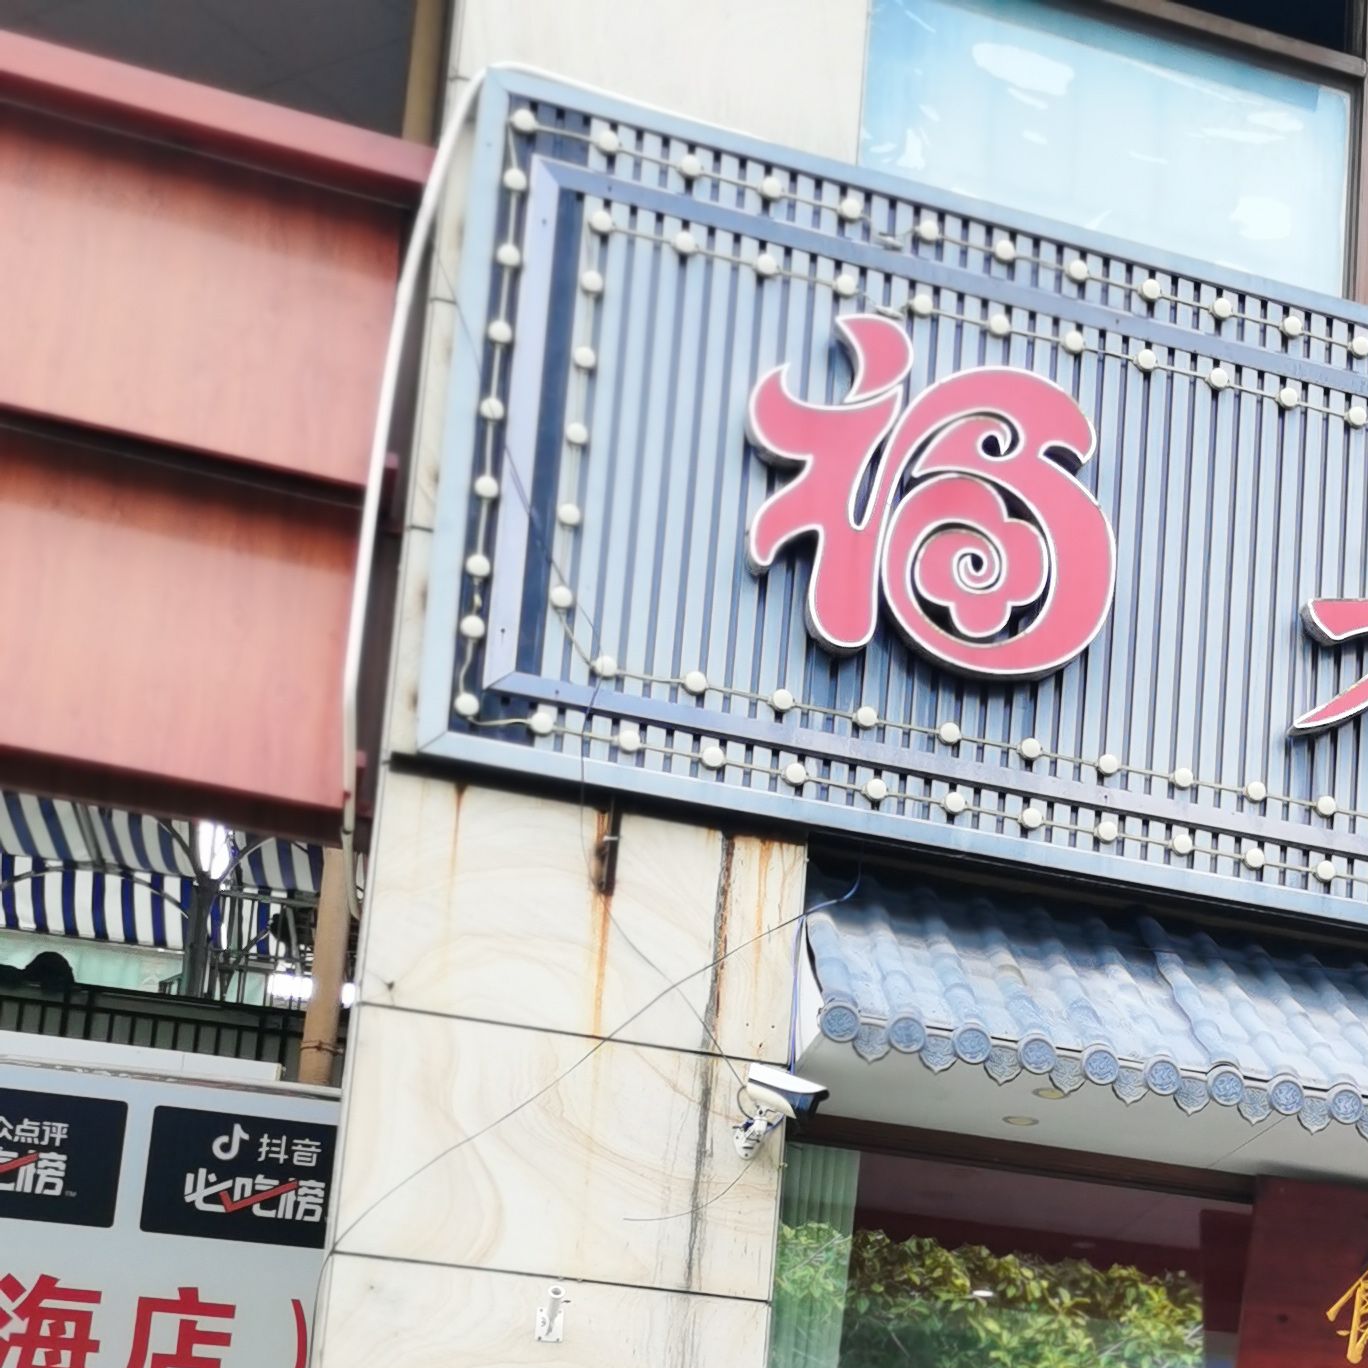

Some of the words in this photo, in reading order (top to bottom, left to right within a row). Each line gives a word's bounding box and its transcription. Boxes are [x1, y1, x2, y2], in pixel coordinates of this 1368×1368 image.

[747, 313, 1117, 675] 福
[257, 1133, 323, 1167] 抖音
[184, 1167, 326, 1222] 必吃榜
